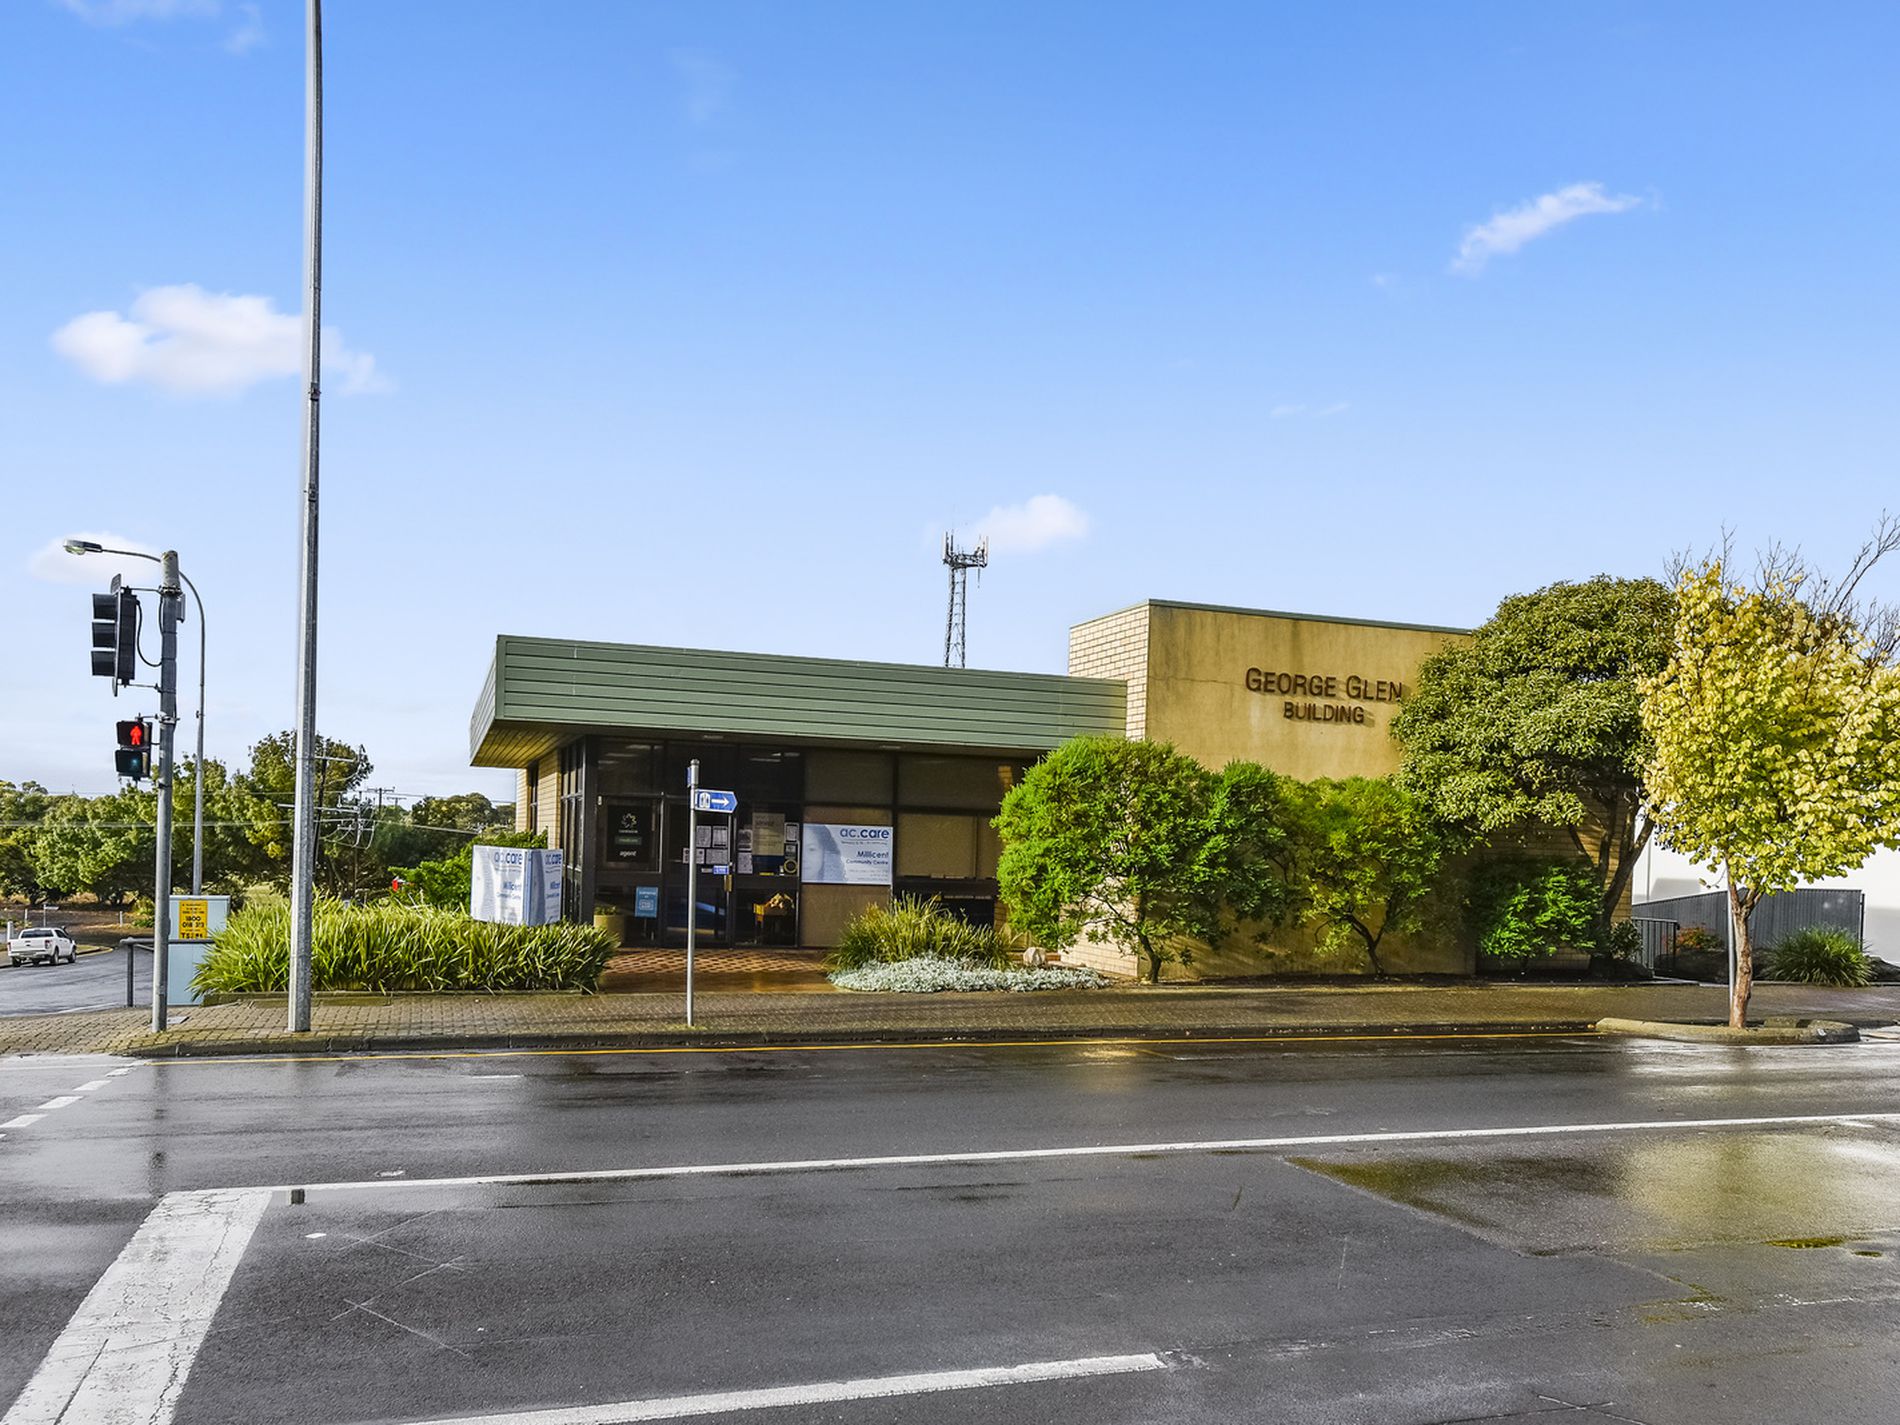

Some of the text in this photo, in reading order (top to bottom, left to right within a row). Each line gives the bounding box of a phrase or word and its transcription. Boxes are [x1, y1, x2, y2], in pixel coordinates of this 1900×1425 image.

[1245, 667, 1403, 701] GEORGE GLEN
[1283, 701, 1365, 724] BUILDING
[840, 828, 889, 839] ac.care
